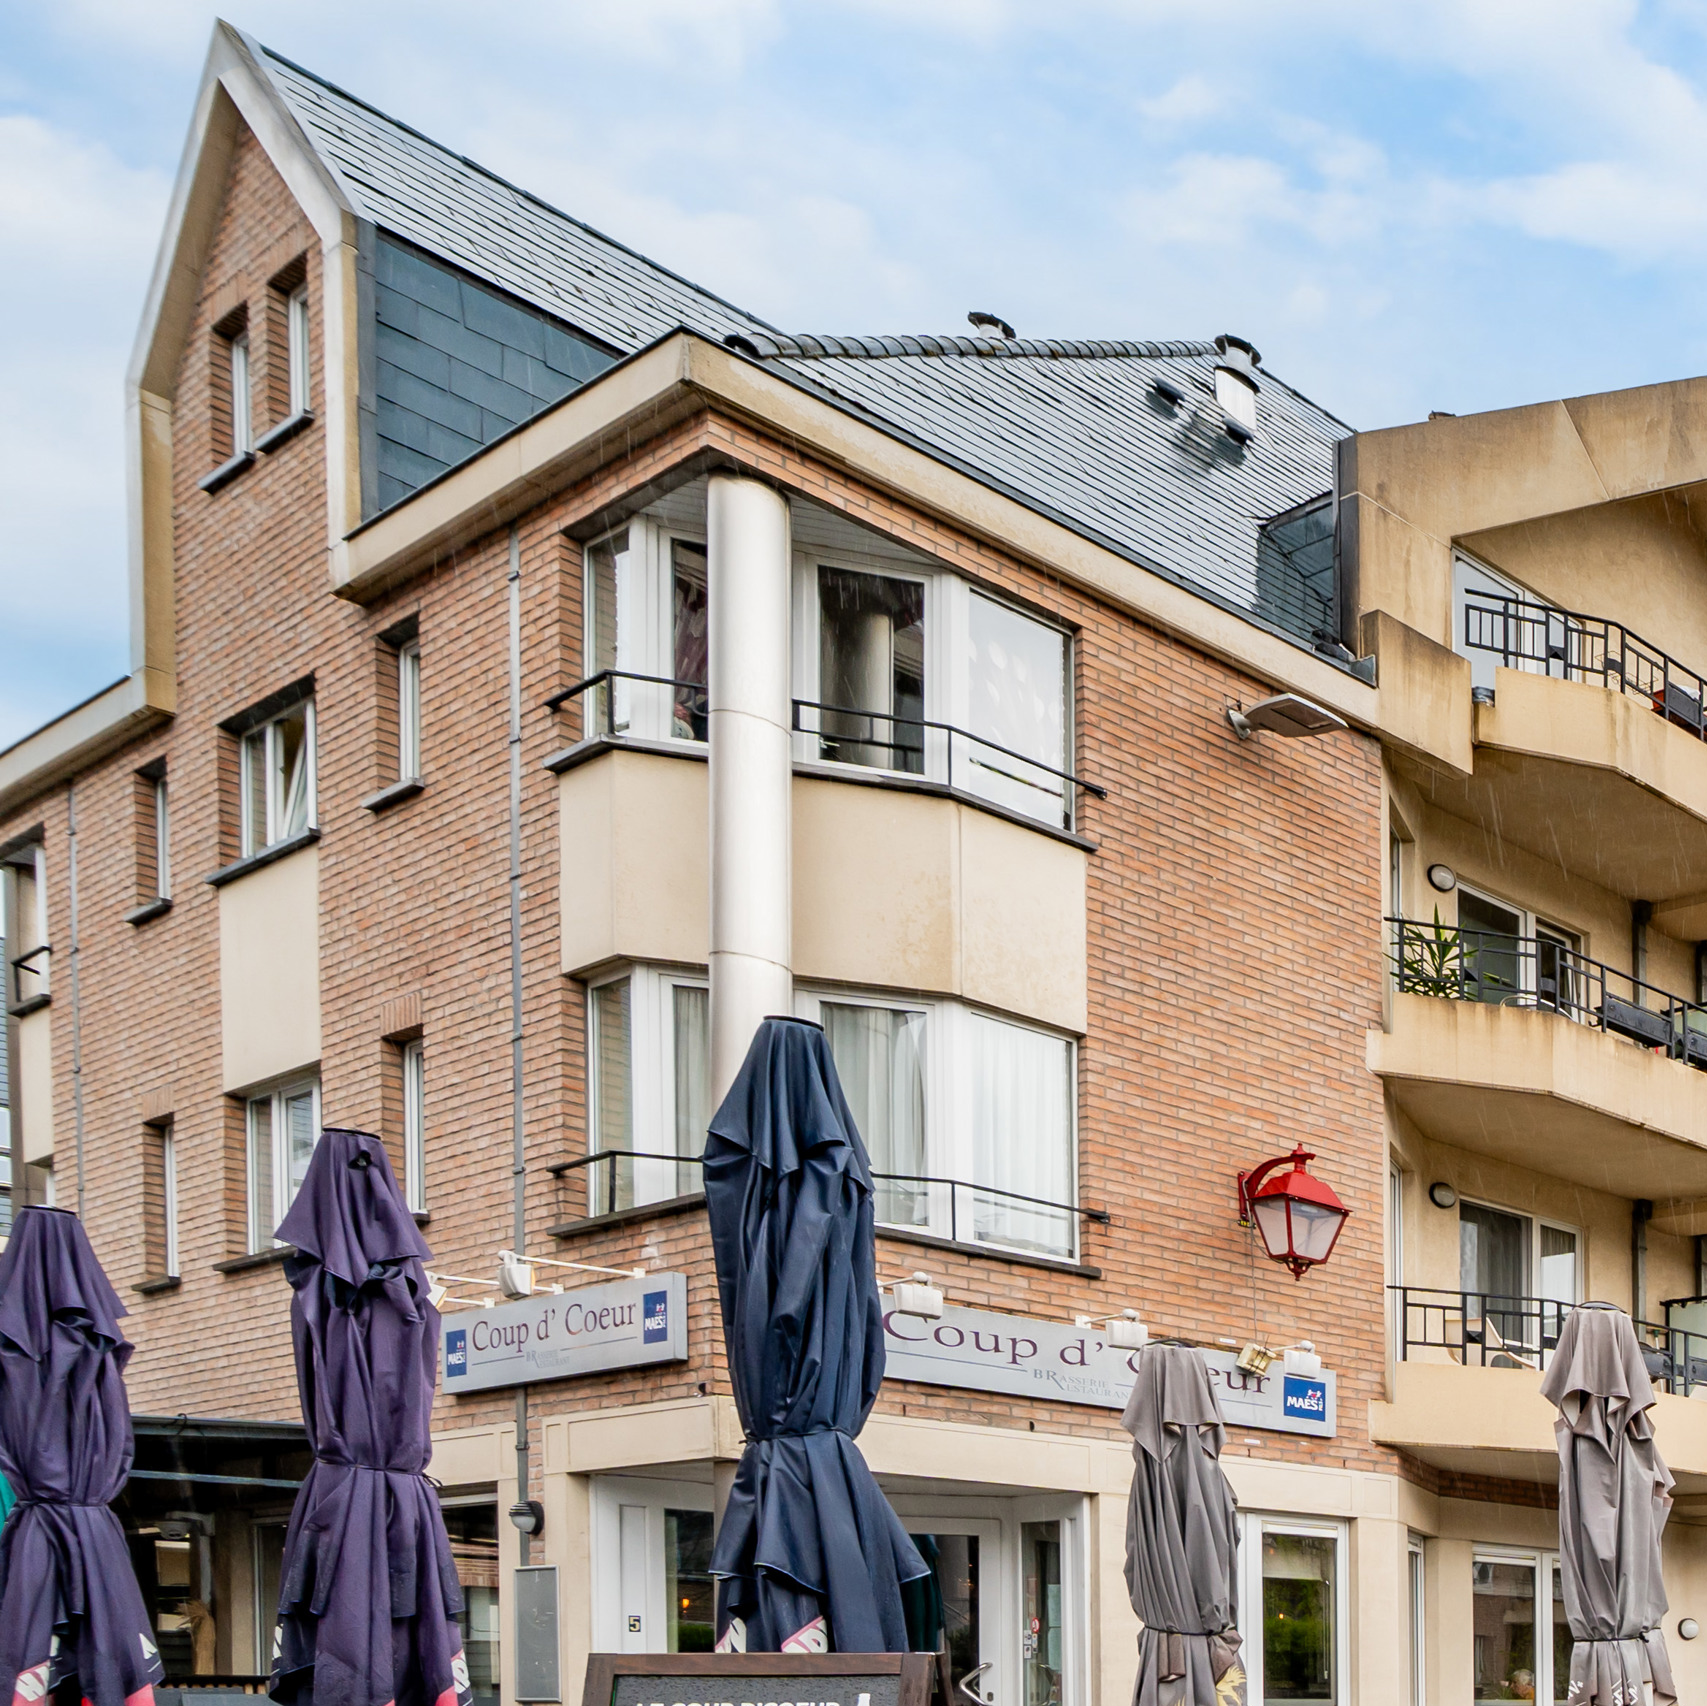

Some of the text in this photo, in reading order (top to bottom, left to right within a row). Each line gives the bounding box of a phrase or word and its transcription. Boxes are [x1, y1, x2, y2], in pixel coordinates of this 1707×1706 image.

[471, 1320, 529, 1353] Coup
[564, 1303, 637, 1336] Coeur
[882, 1309, 1038, 1366] Coup
[1126, 1347, 1271, 1395] eur
[1286, 1395, 1319, 1411] MAES
[629, 1616, 641, 1631] 5
